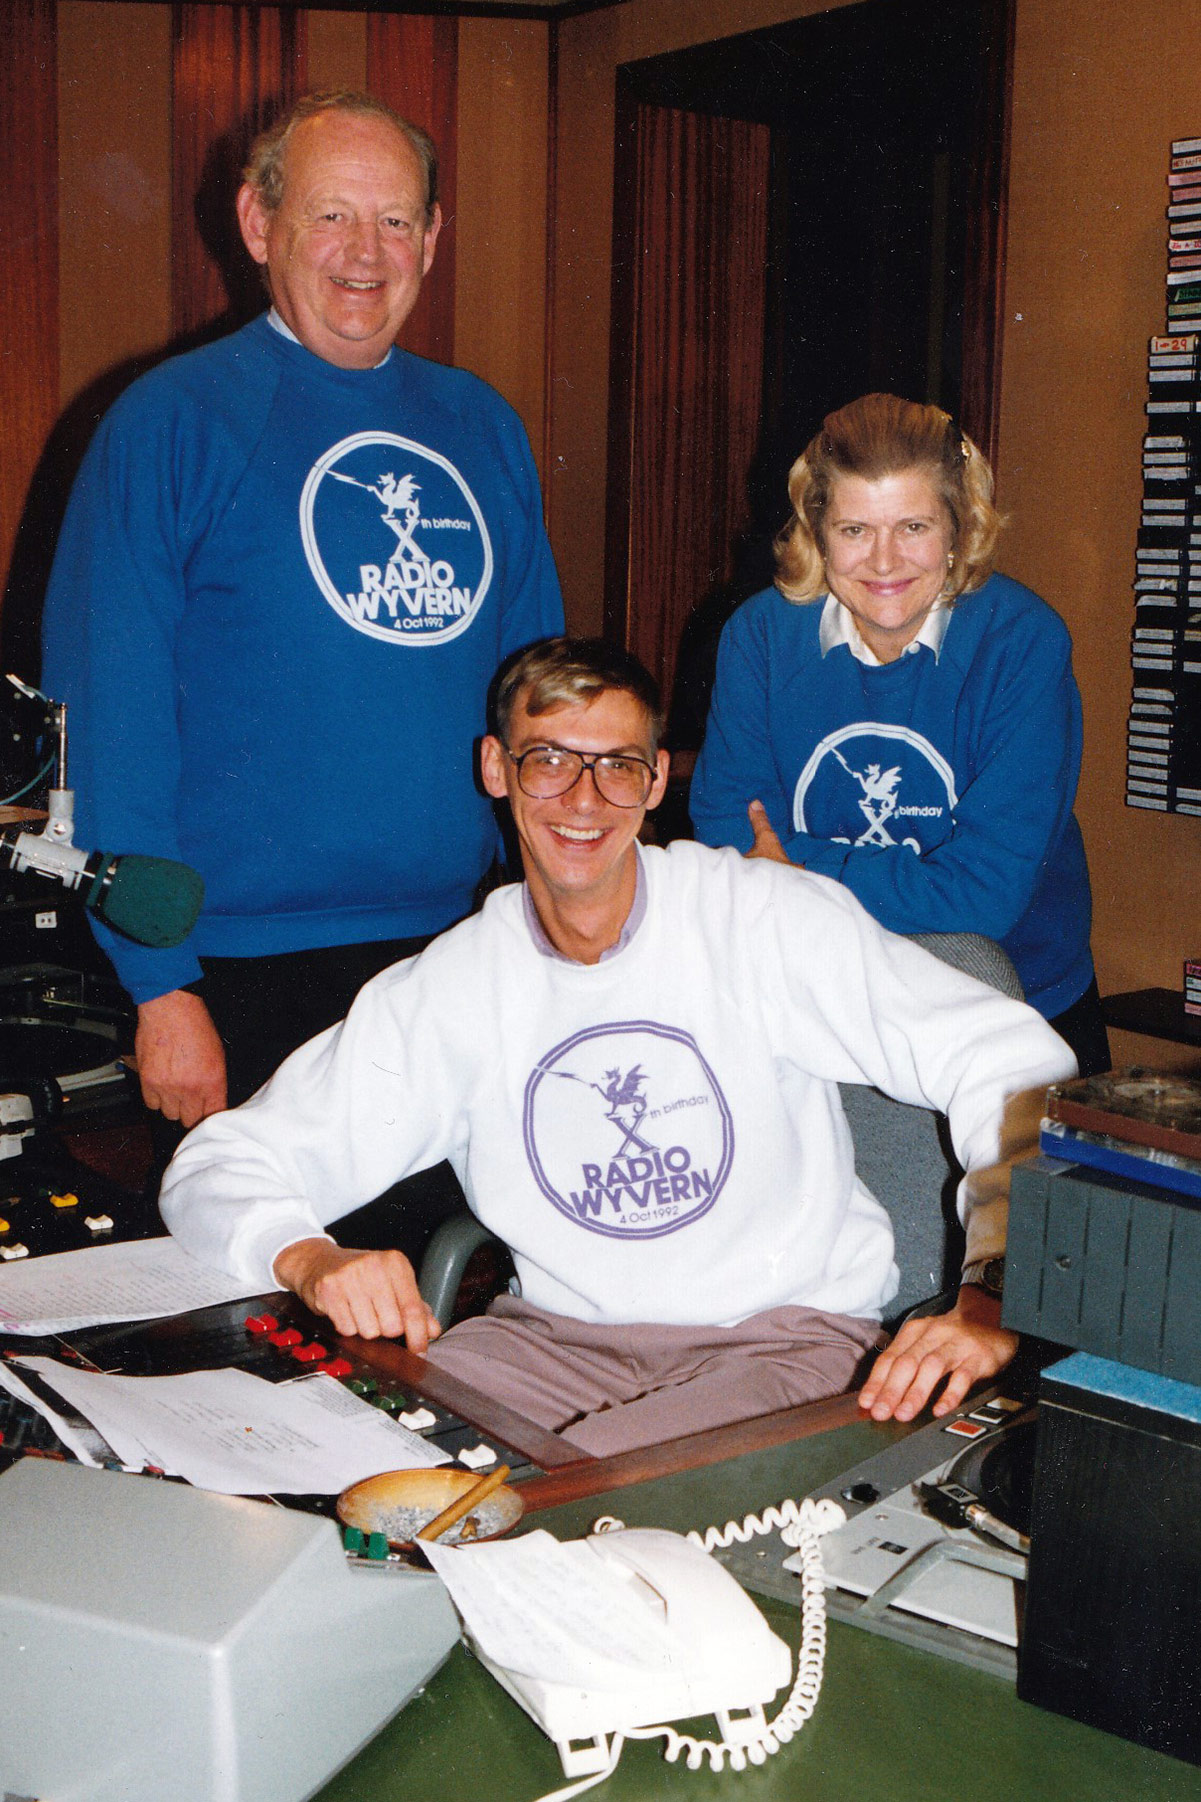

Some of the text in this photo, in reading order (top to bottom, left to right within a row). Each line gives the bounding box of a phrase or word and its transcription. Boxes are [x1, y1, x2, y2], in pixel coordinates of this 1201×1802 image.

[433, 518, 471, 531] birthday
[360, 561, 454, 593] RADIO
[346, 587, 471, 620] WYVERN
[394, 617, 444, 629] 4 Oct 1992
[899, 806, 943, 818] birthday
[663, 1094, 709, 1115] birthday
[582, 1146, 691, 1189] RADIO
[569, 1168, 713, 1219] WYVERN
[619, 1206, 679, 1224] 4 Oct 1992
